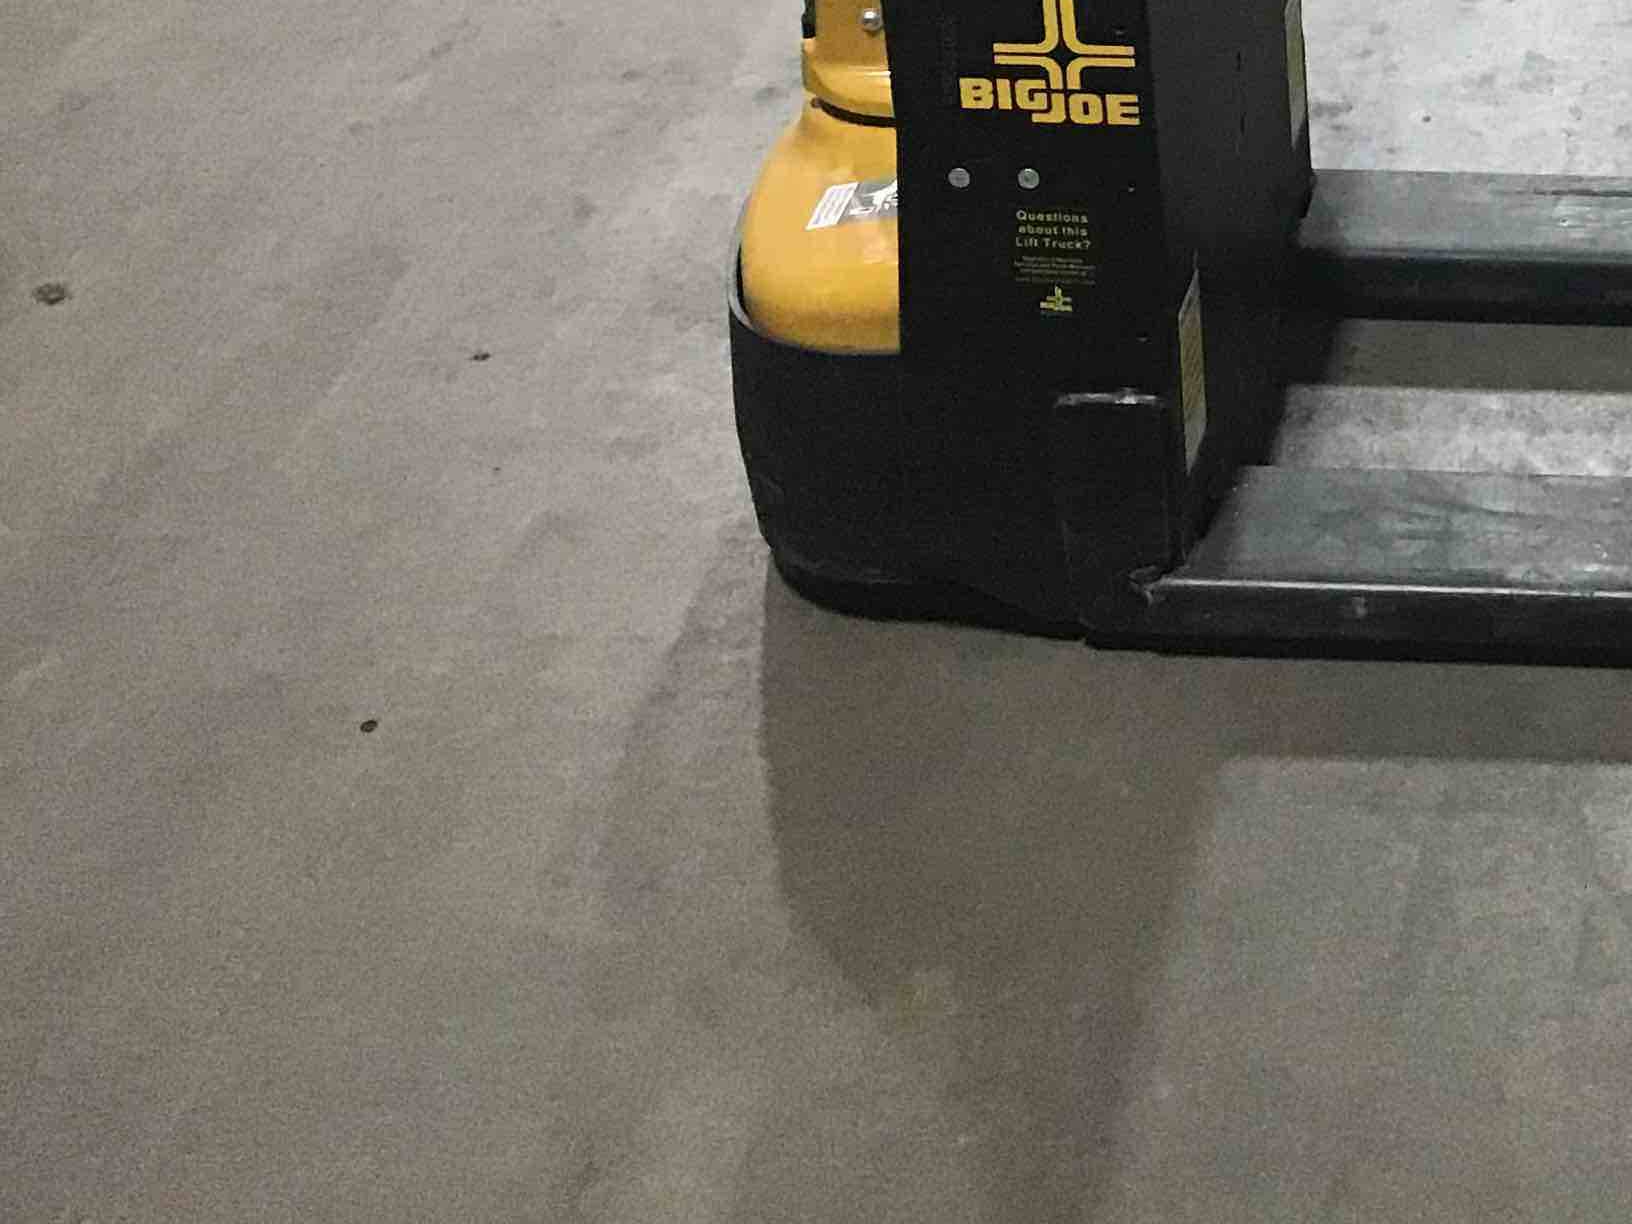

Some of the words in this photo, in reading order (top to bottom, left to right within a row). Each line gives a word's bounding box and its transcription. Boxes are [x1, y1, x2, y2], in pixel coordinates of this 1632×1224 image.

[1015, 209, 1088, 224] Questions
[1018, 224, 1058, 236] about
[1062, 226, 1088, 237] this
[1015, 236, 1039, 248] Lift
[1042, 237, 1091, 250] Truck?
